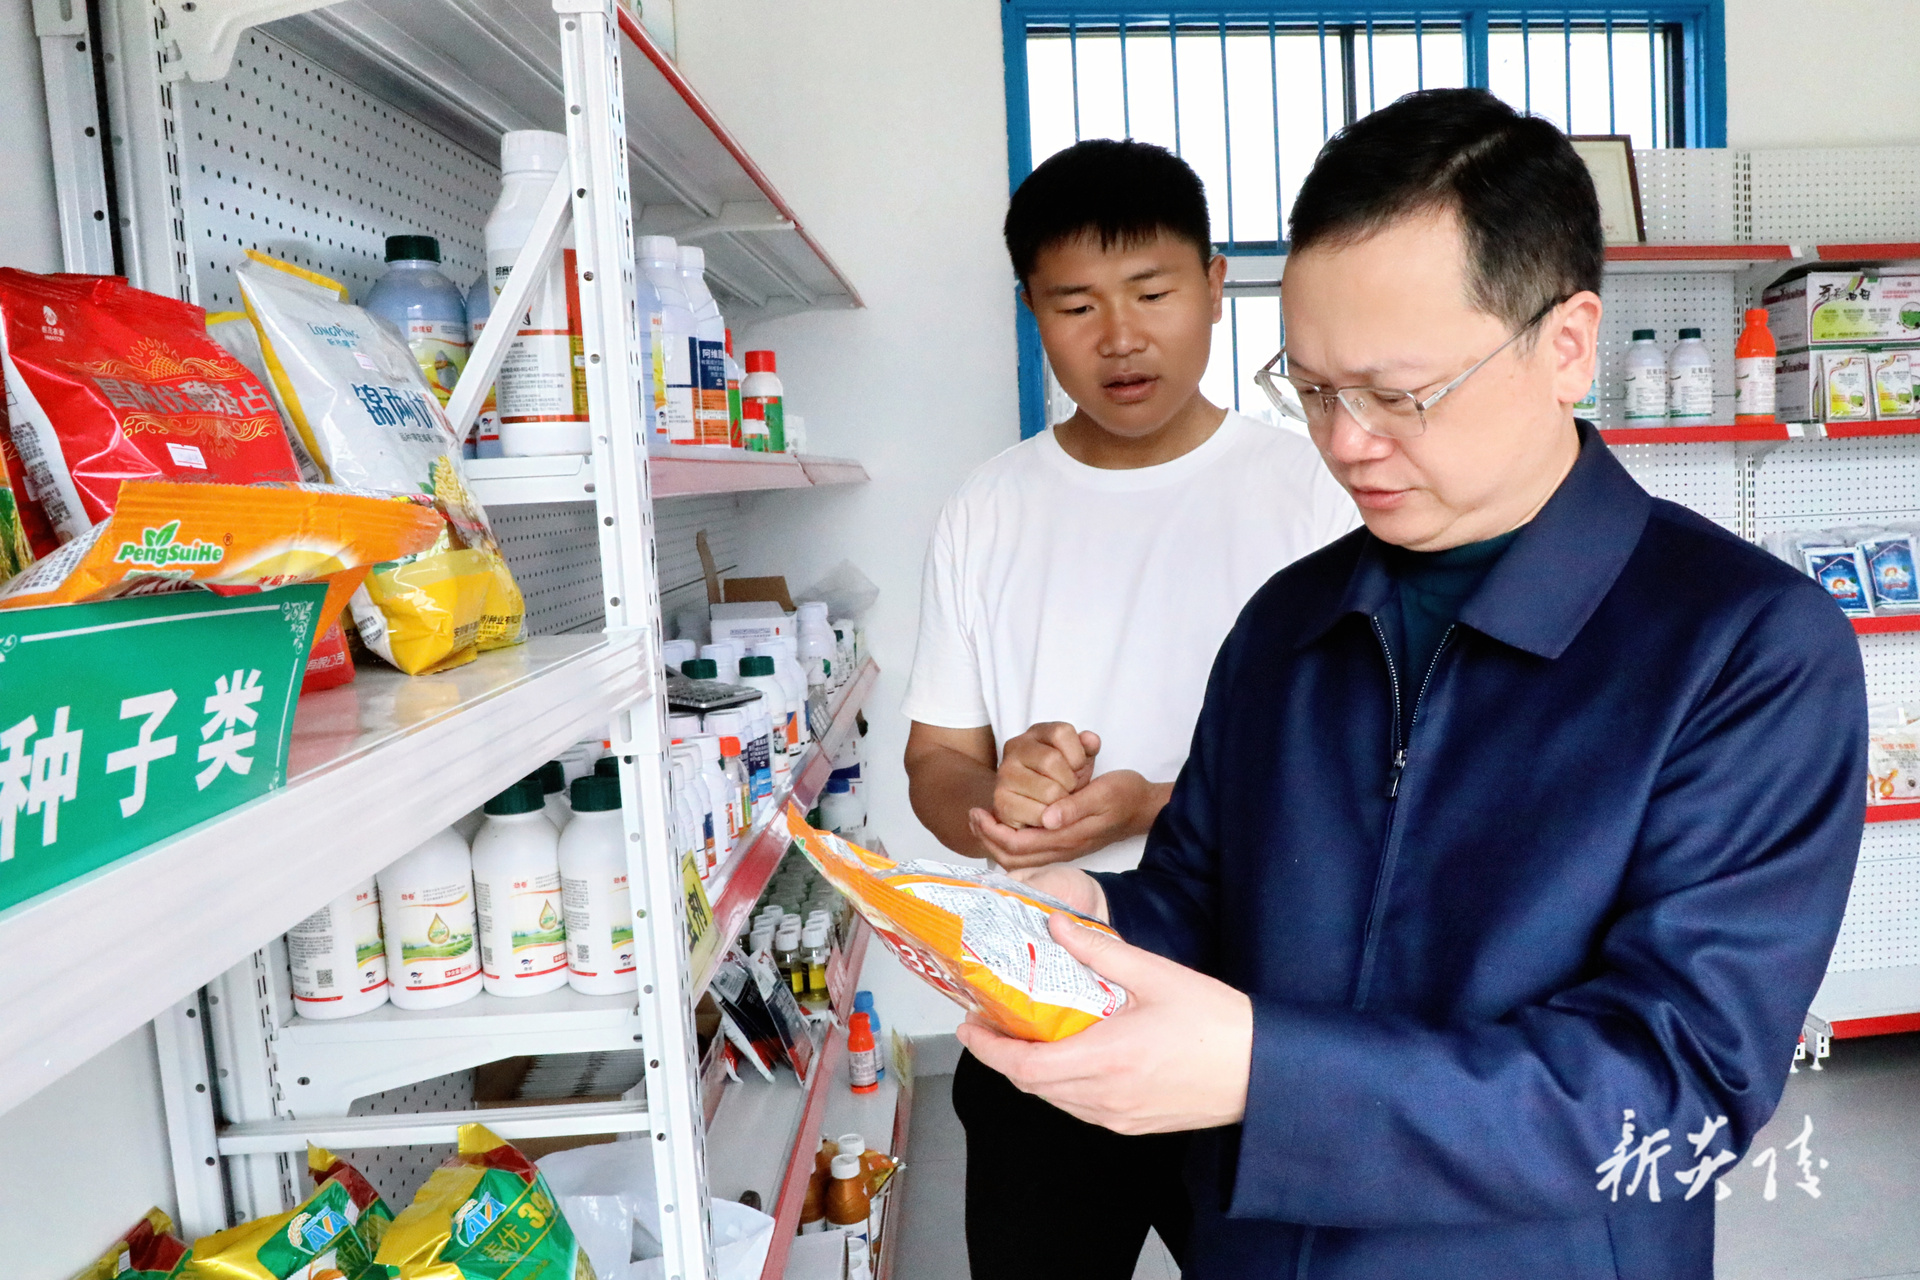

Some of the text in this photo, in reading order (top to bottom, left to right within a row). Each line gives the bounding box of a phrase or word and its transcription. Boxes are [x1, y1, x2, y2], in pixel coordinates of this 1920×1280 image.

[116, 541, 224, 566] PengSuiHe
[0, 668, 265, 862] 种子类
